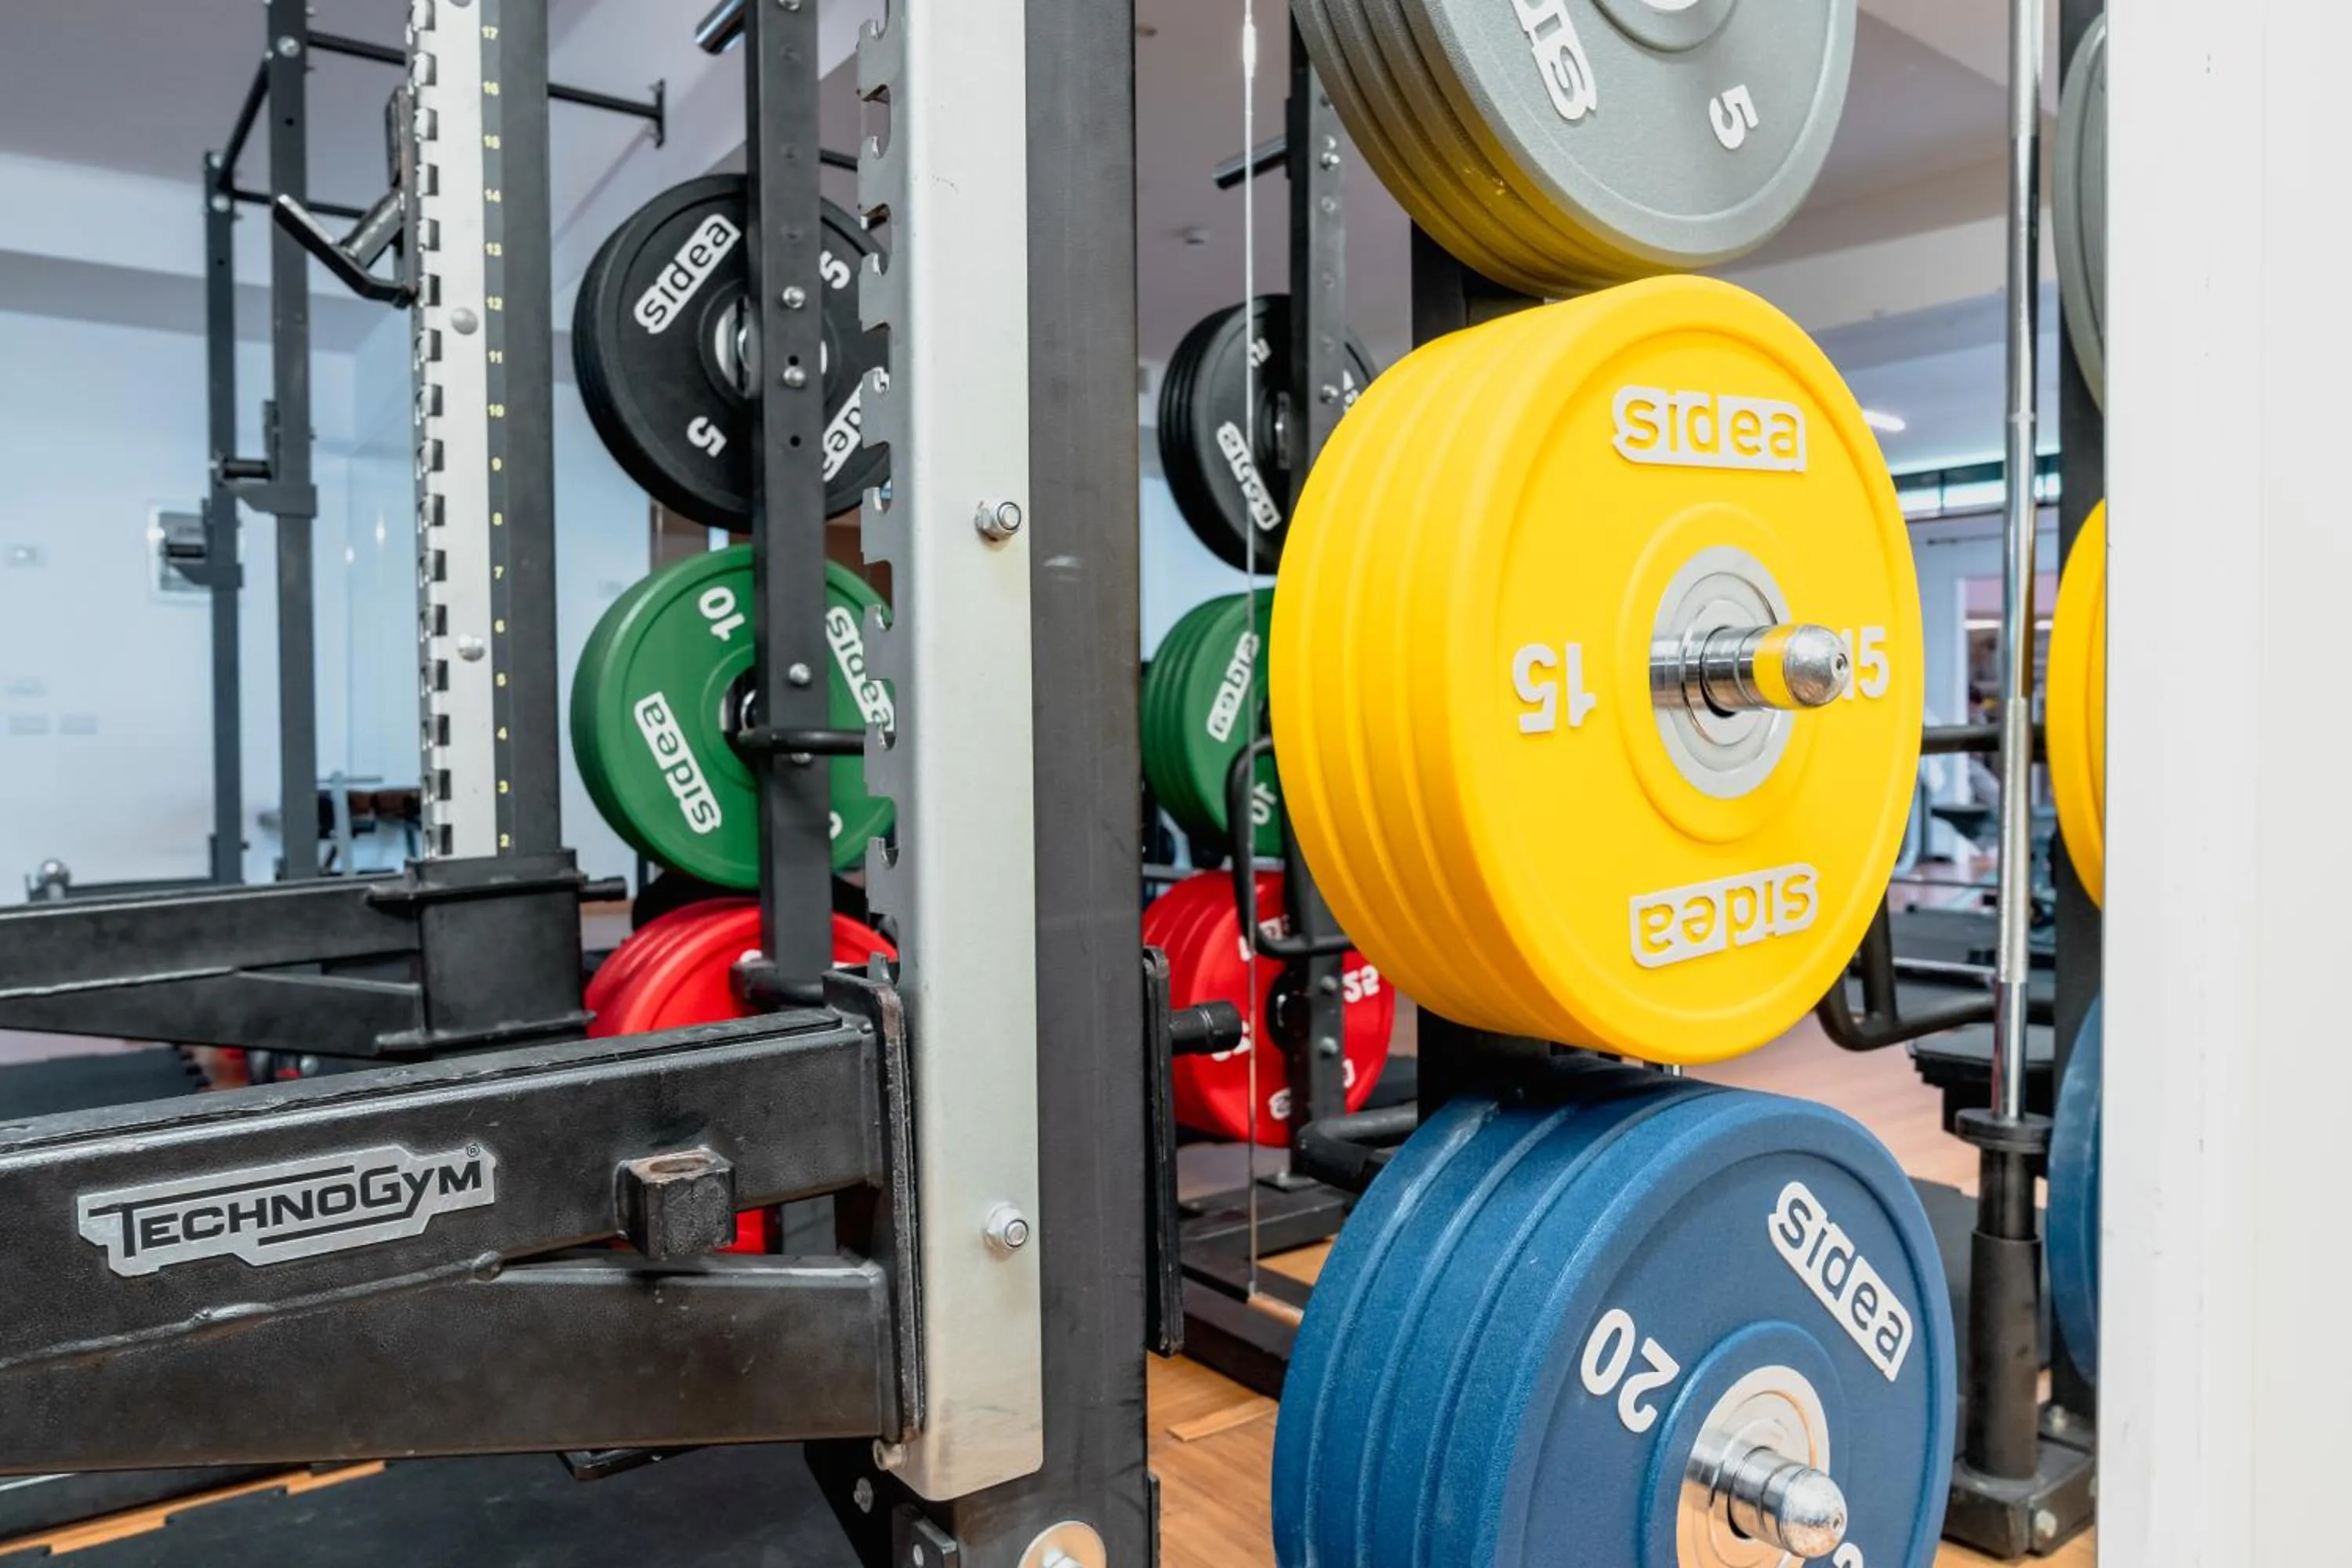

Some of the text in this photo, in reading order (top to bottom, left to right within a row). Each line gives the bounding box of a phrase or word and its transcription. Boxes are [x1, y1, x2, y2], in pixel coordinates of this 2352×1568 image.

[482, 26, 499, 39] 17
[1709, 84, 1759, 149] 5
[485, 190, 501, 202] 14
[637, 216, 737, 331] sidea
[820, 250, 850, 289] 5
[486, 297, 503, 310] 12
[488, 350, 503, 363] 11
[488, 405, 504, 417] 10
[1617, 390, 1802, 468] sidea
[687, 416, 727, 457] 5
[492, 458, 502, 471] 9
[493, 513, 503, 526] 8
[494, 566, 504, 579] 7
[699, 586, 745, 641] 10
[495, 619, 505, 633] 6
[1512, 642, 1596, 734] 15
[497, 727, 507, 740] 4
[637, 695, 720, 832] sidea
[499, 780, 508, 793] 3
[500, 833, 510, 847] 2
[1632, 866, 1817, 964] sidea
[1772, 1187, 1911, 1374] sidea
[1581, 1309, 1679, 1433] 20
